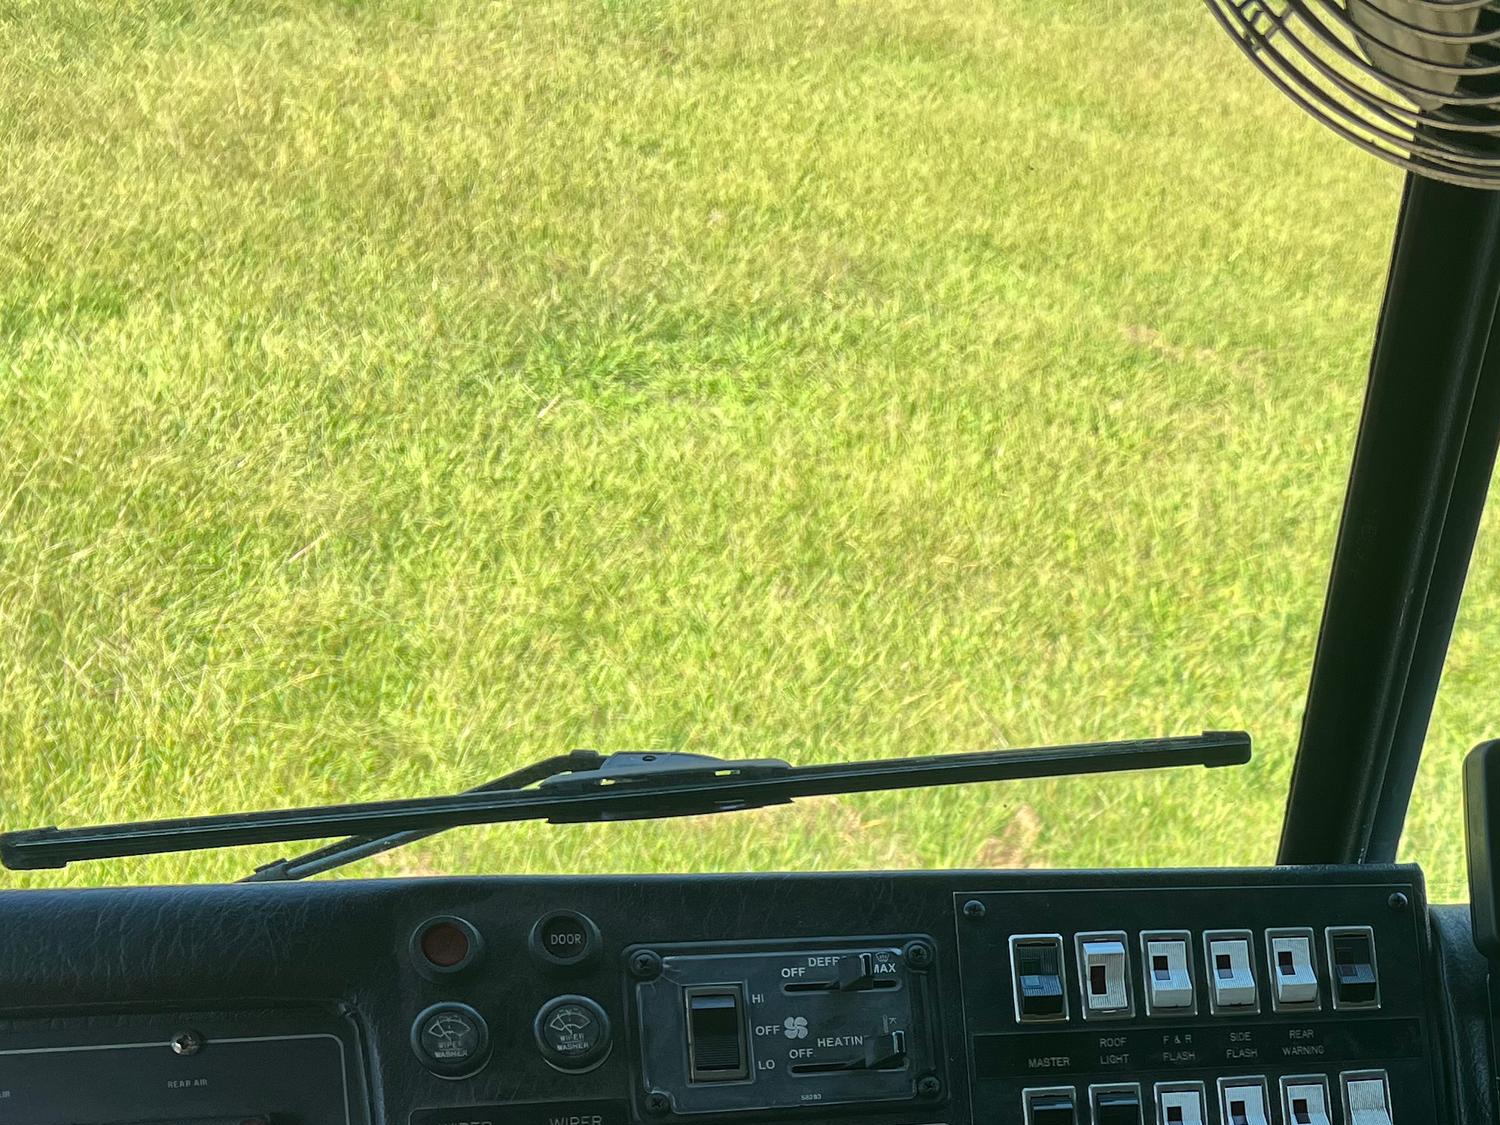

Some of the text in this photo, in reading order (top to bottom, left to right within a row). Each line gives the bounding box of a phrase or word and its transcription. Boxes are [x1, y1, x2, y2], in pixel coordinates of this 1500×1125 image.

[550, 934, 582, 945] DOOR
[781, 967, 806, 978] OFF
[752, 994, 764, 1004] HI
[755, 1025, 781, 1036] OFF
[1289, 1029, 1314, 1039] REAR
[816, 1035, 864, 1048] HEATIN
[1100, 1037, 1128, 1047] ROOF
[1230, 1032, 1252, 1042] SIDE
[788, 1049, 814, 1060] OFF
[1226, 1048, 1258, 1059] FLASH
[1282, 1045, 1325, 1056] WARNING
[1100, 1054, 1130, 1065] LIGHT
[1163, 1051, 1196, 1062] FLASH
[758, 1060, 775, 1070] LO
[1029, 1057, 1071, 1068] MASTER
[167, 1079, 191, 1088] REAR
